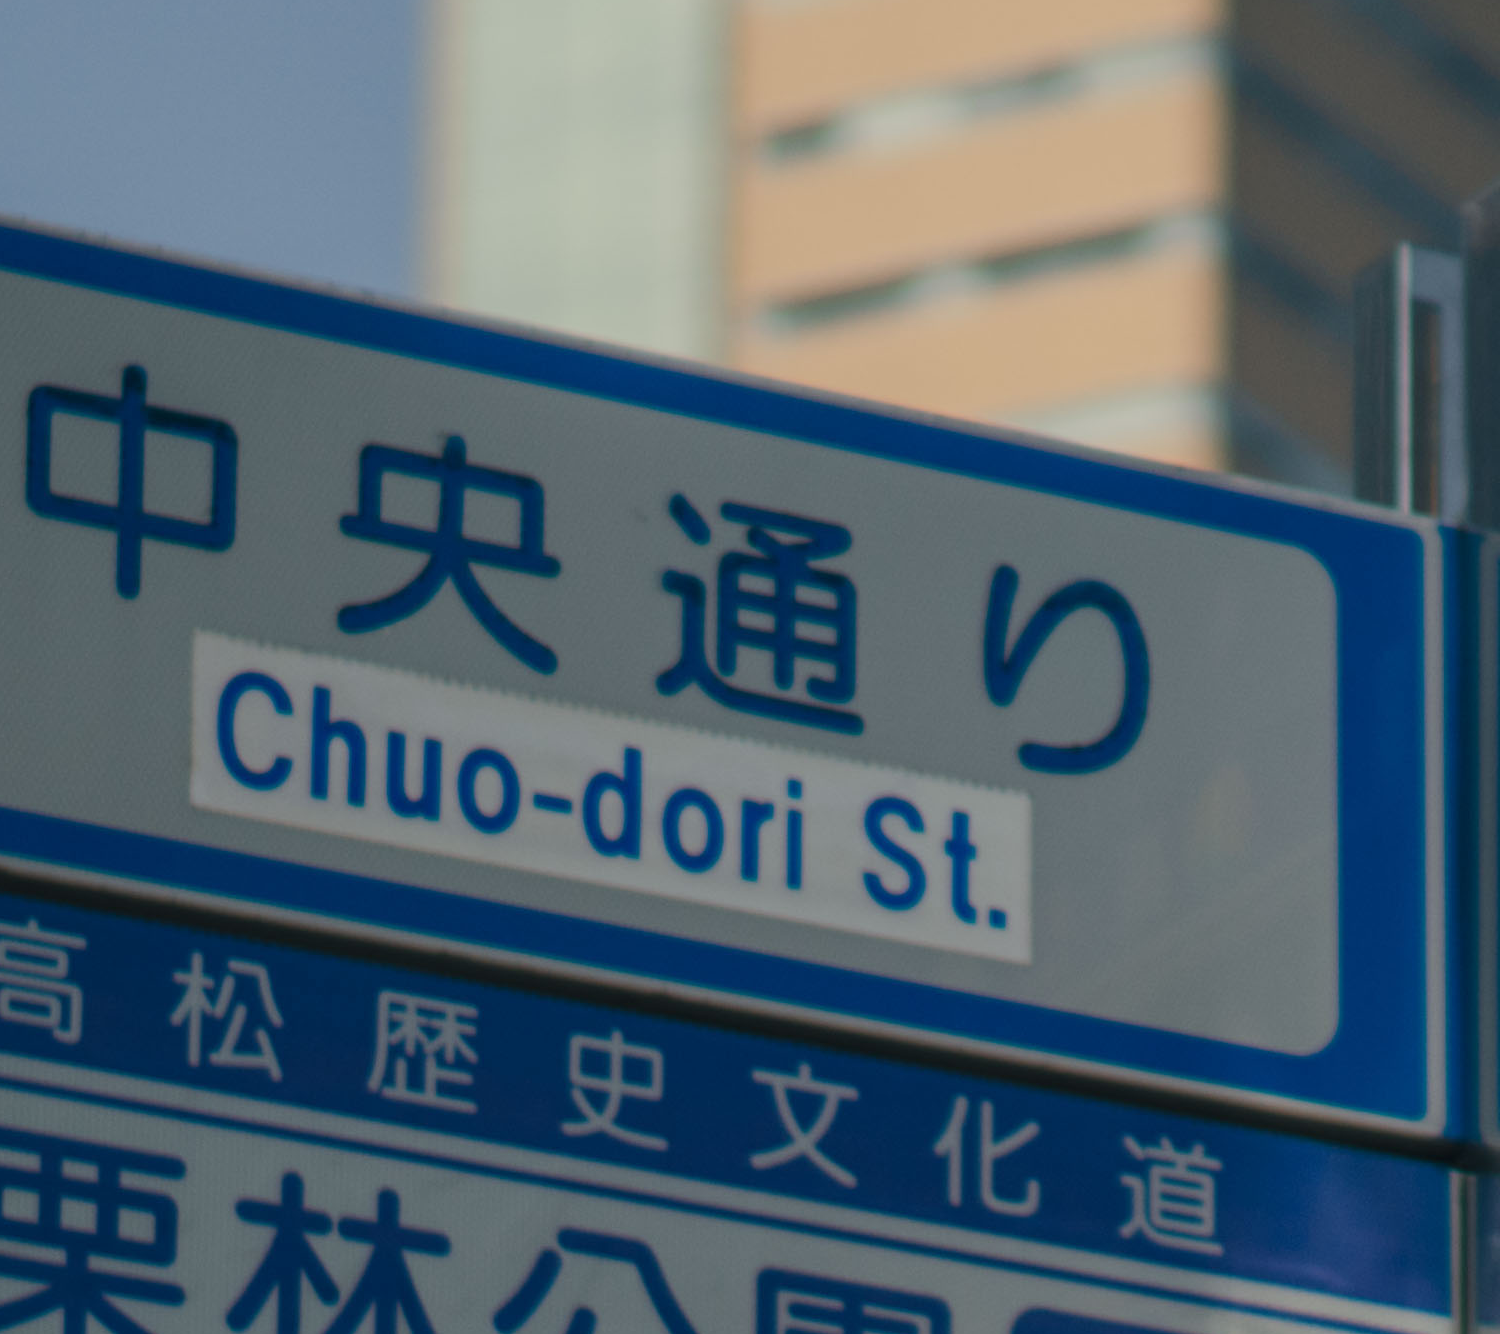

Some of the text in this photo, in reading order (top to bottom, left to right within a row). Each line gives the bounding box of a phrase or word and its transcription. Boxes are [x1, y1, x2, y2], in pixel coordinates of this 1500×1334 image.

[24, 364, 1150, 775] 中央通り
[217, 672, 1006, 929] Chuo-dori St.
